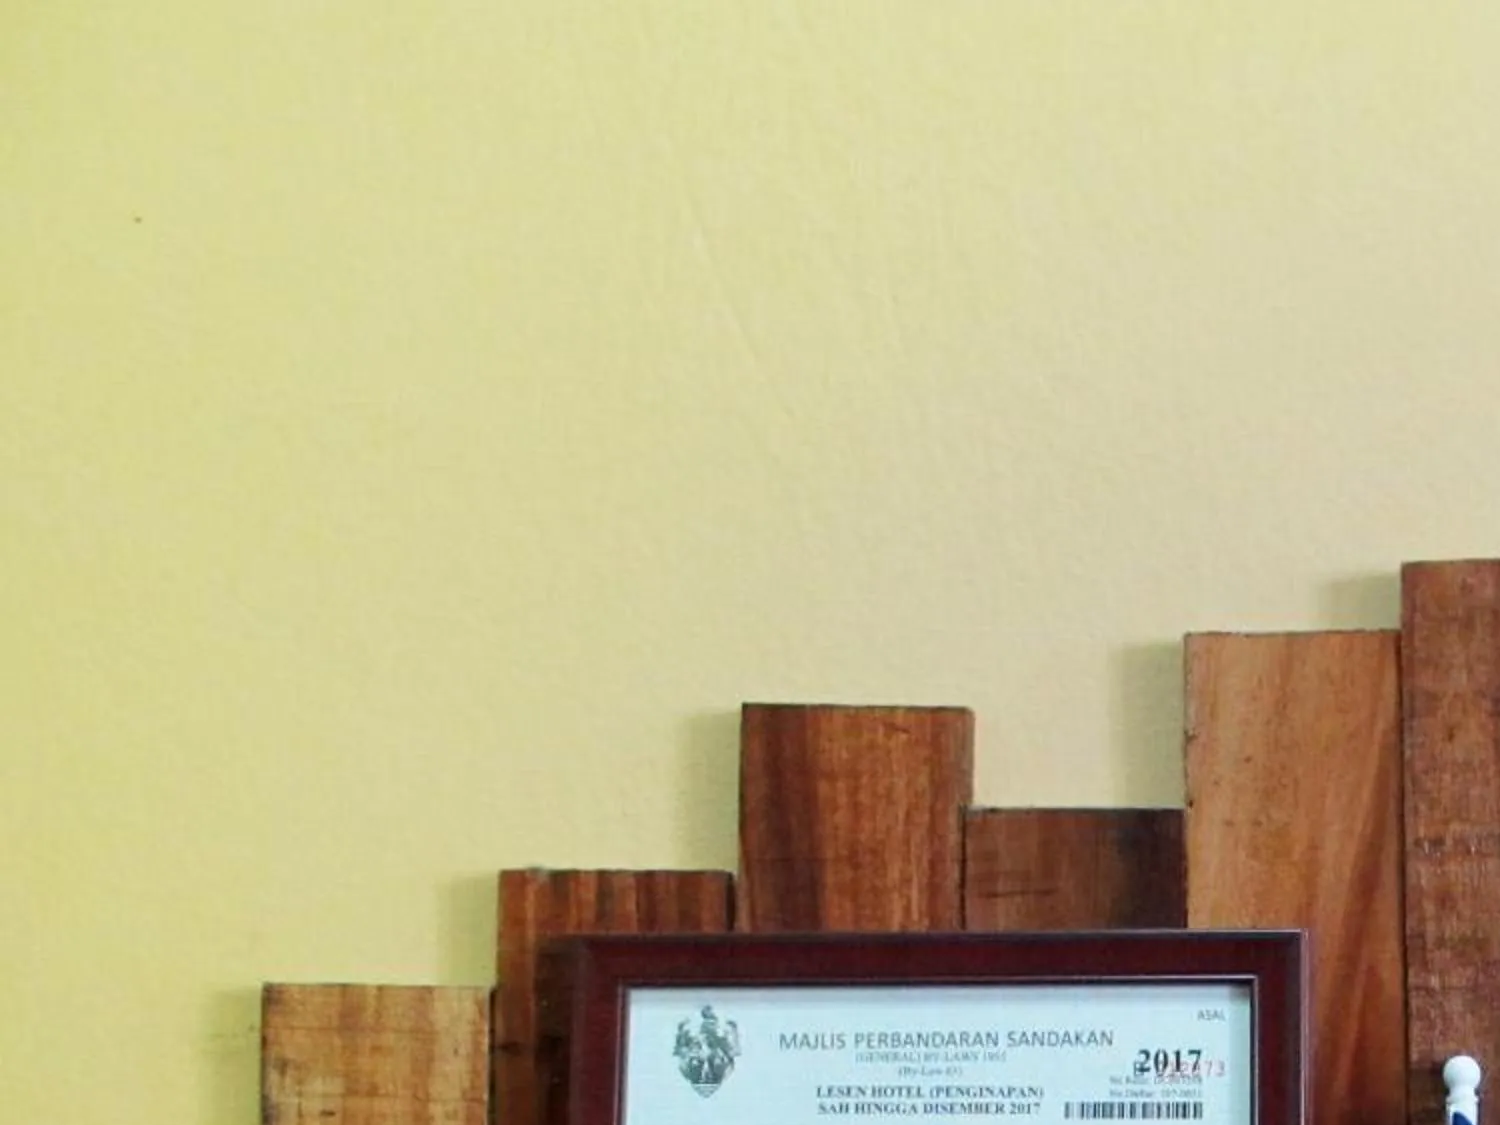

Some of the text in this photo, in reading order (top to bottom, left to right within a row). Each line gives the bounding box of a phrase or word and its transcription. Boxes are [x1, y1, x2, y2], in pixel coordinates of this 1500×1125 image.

[778, 1031, 1114, 1051] MAJLIS PERBANDARAN SANDAKAN
[1137, 1049, 1202, 1073] 2017
[816, 1085, 1044, 1099] LESEN HOTEL (PENGINAPAN)
[817, 1103, 1041, 1115] SAH HINGGA DISEMBER 2017
